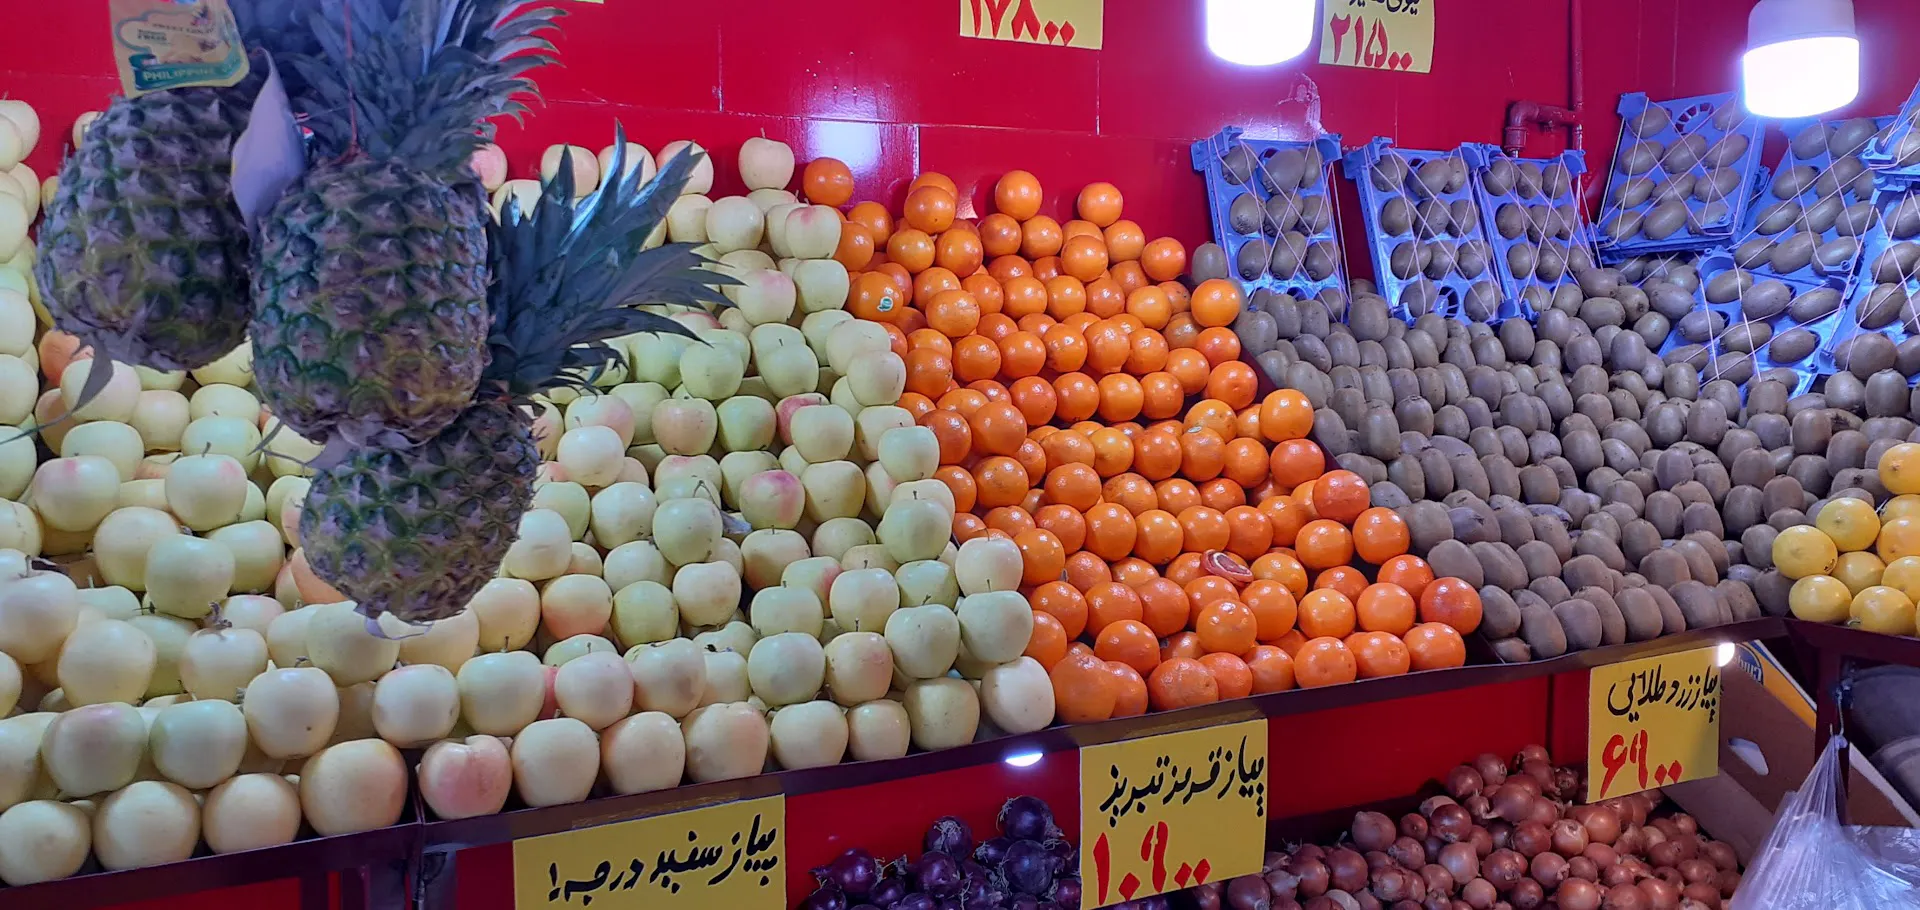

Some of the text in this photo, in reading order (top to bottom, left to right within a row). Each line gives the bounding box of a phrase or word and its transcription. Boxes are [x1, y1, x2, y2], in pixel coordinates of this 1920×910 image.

[969, 0, 1076, 46] ۱۷۸۰۰
[1329, 12, 1413, 71] ۲۱۵۰۰
[1607, 663, 1667, 722] طلایی
[1665, 674, 1696, 710] زرد
[1687, 664, 1718, 723] پیاز
[1099, 735, 1265, 828] پیاز قرمز تبریز
[1600, 729, 1683, 800] ۶۹۰۰
[649, 830, 723, 894] سفید
[707, 813, 779, 887] پیاز
[1092, 820, 1211, 907] ۱۰۹۰۰
